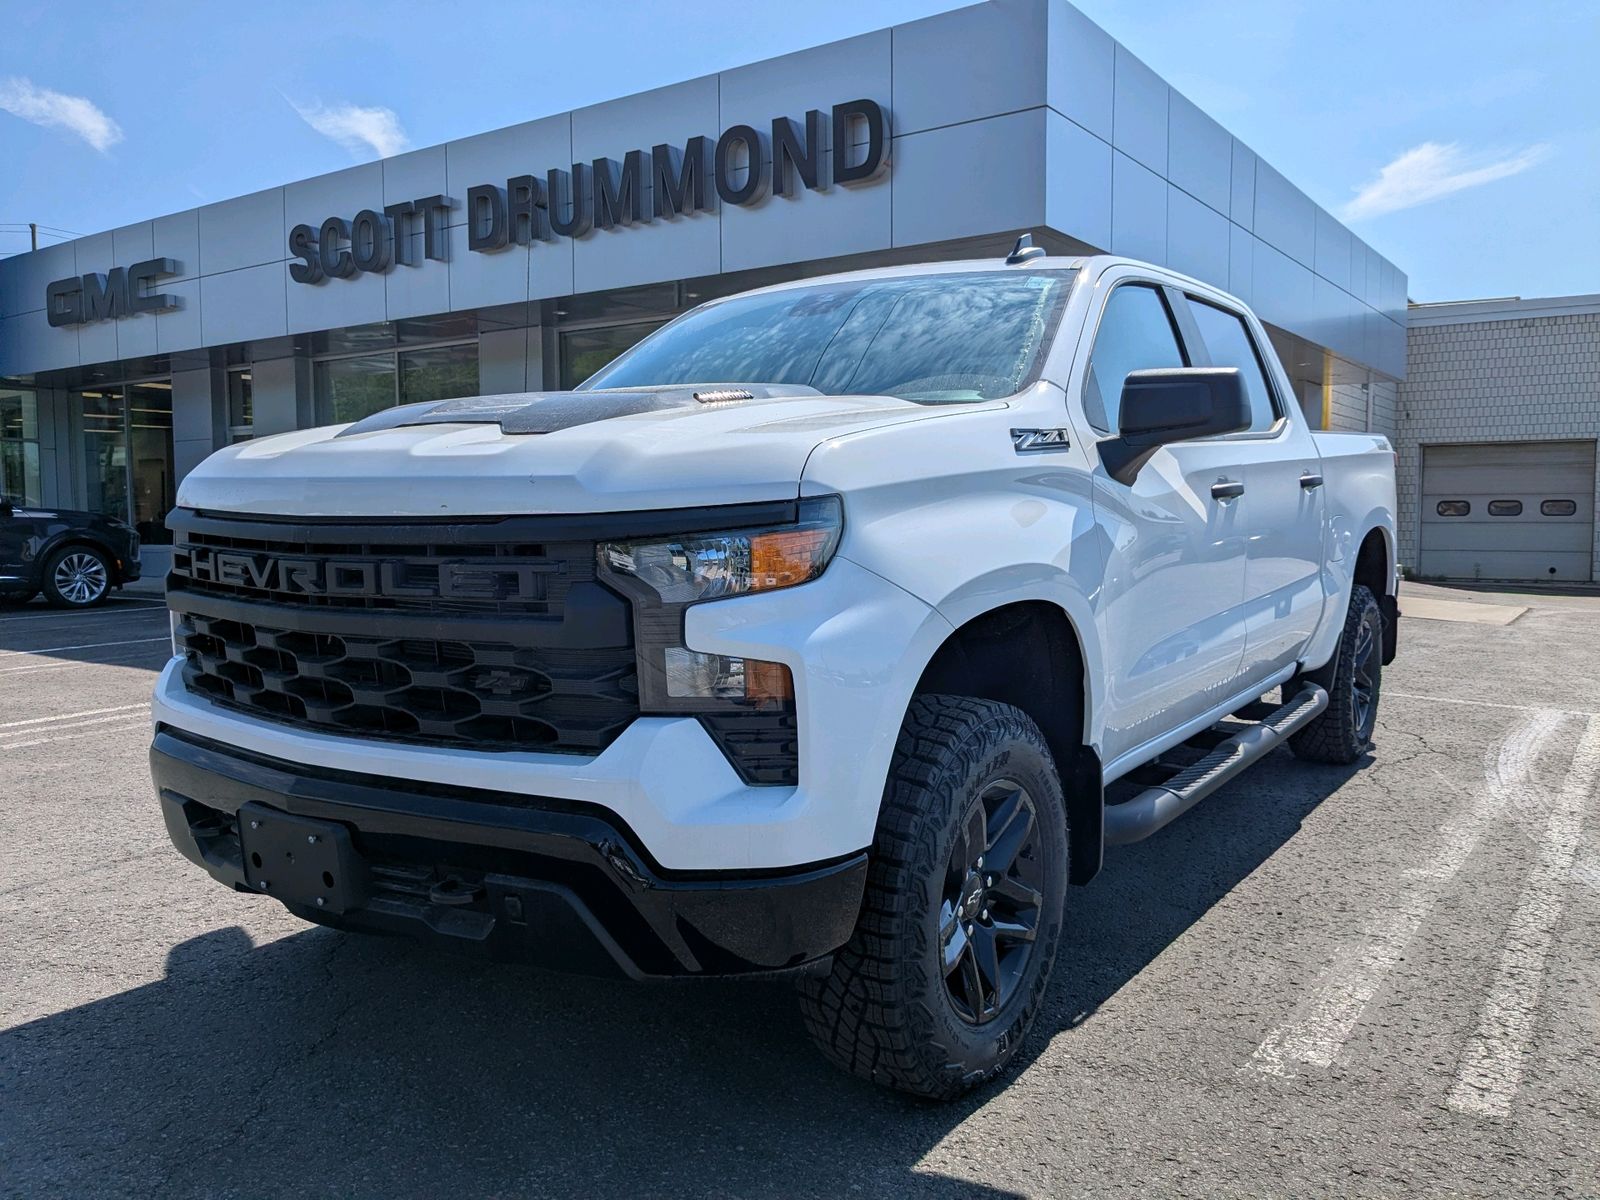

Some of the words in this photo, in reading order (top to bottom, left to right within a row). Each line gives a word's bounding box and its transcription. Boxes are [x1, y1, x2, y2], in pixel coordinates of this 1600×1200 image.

[289, 194, 452, 284] SCOTT
[467, 99, 889, 253] DRUMMOND
[47, 257, 180, 327] GMC
[1010, 428, 1070, 452] Z71
[172, 548, 566, 599] CHEVROLET
